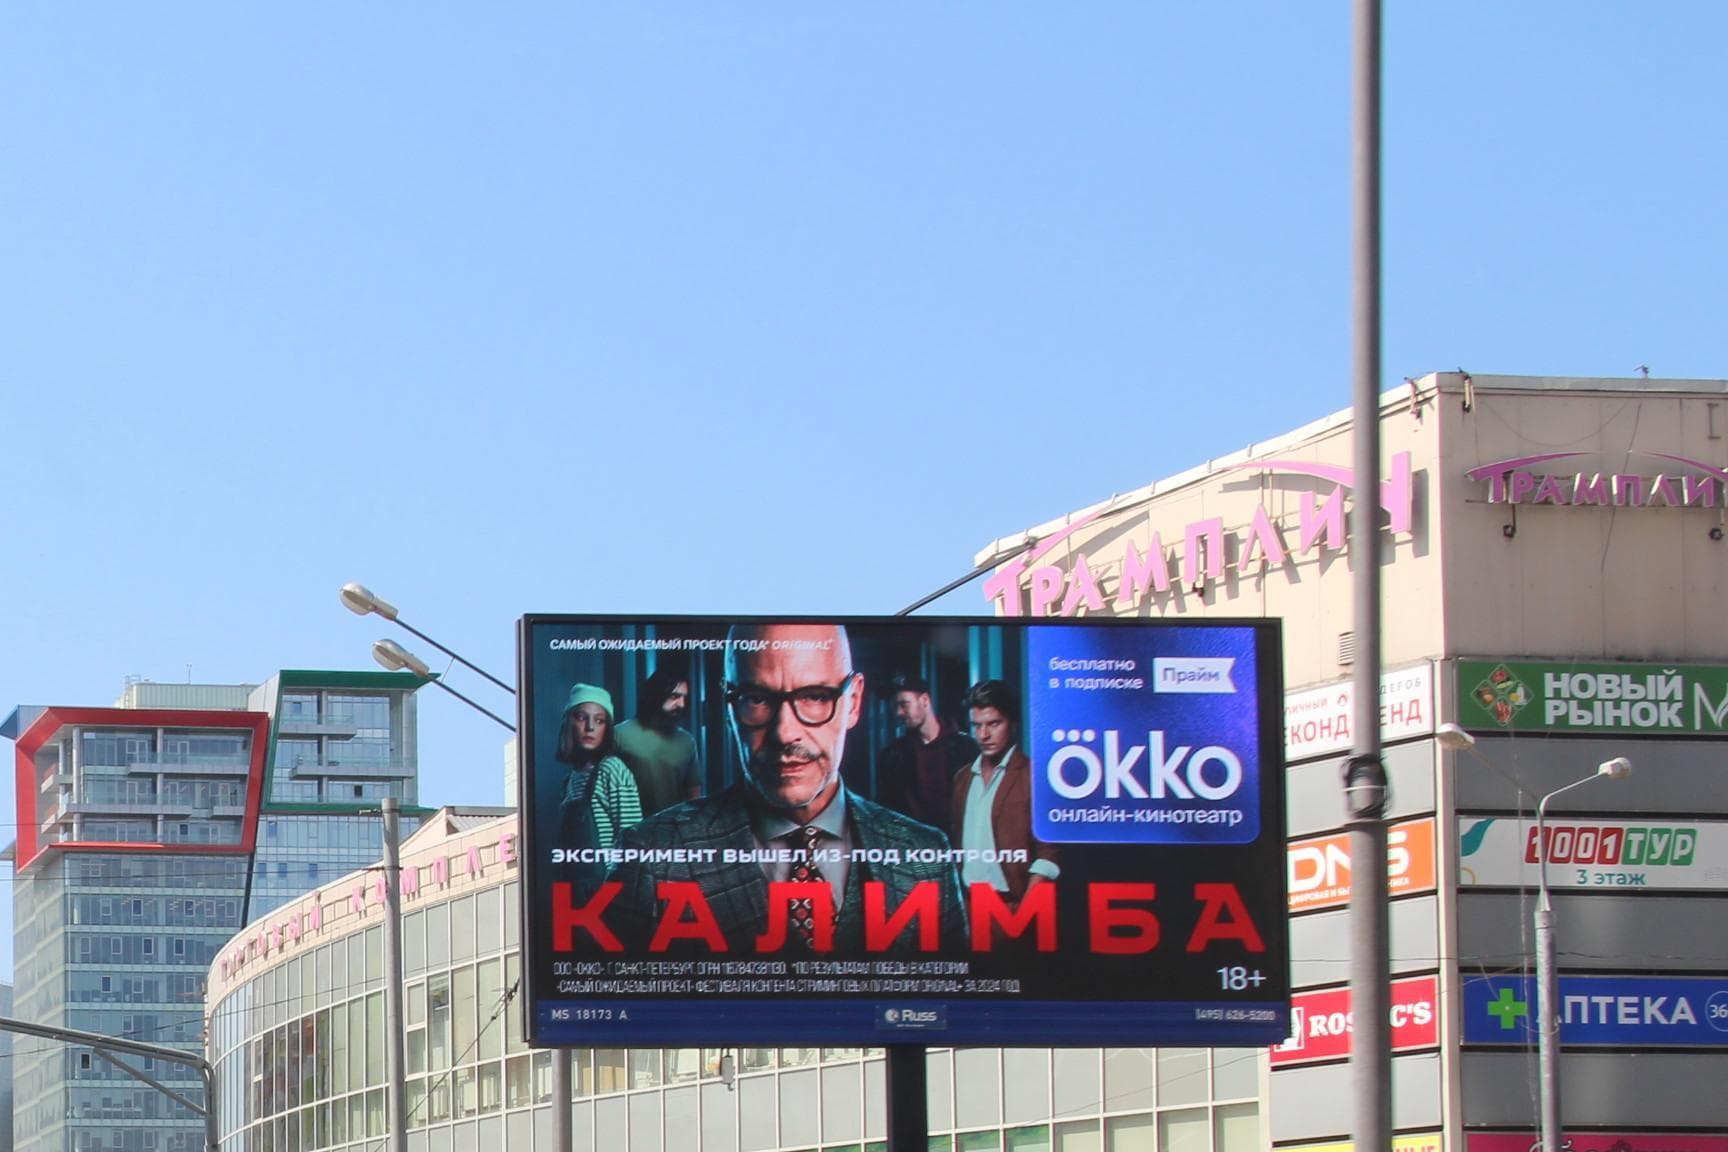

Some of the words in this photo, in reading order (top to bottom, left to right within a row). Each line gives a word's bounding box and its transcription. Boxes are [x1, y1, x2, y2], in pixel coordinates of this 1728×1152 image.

[1465, 451, 1728, 507] ТРАМПЛИ
[549, 637, 597, 651] САМЫЙ
[598, 637, 682, 651] ОЖИДАЕМЫЙ
[684, 639, 731, 651] ПРОЕКТ
[1048, 656, 1136, 671] бесплатно
[1049, 678, 1060, 689] в
[1065, 677, 1144, 691] подписке
[1162, 667, 1220, 685] Прайм
[1544, 669, 1683, 700] НОВЫЙ
[1544, 700, 1684, 728] РЫНОК
[1285, 713, 1350, 745] КОНД
[1048, 805, 1243, 826] онлайн-кинотеатр
[551, 848, 714, 864] ЭКСПЕРИМЕНТ
[723, 848, 810, 864] ВЫШЕЛ
[813, 848, 902, 866] ИЗ-ПОД
[905, 848, 1028, 864] КОНТРОЛЯ
[1576, 869, 1588, 885] 3
[1593, 871, 1646, 885] этаж
[552, 882, 1265, 953] КАЛИМБА
[1216, 966, 1267, 991] 18+
[551, 1009, 570, 1020] MS
[576, 1009, 612, 1020] 18173
[901, 1009, 937, 1022] Russ
[1309, 1001, 1432, 1038] ROSC'S
[1536, 995, 1697, 1025] ПТЕКА
